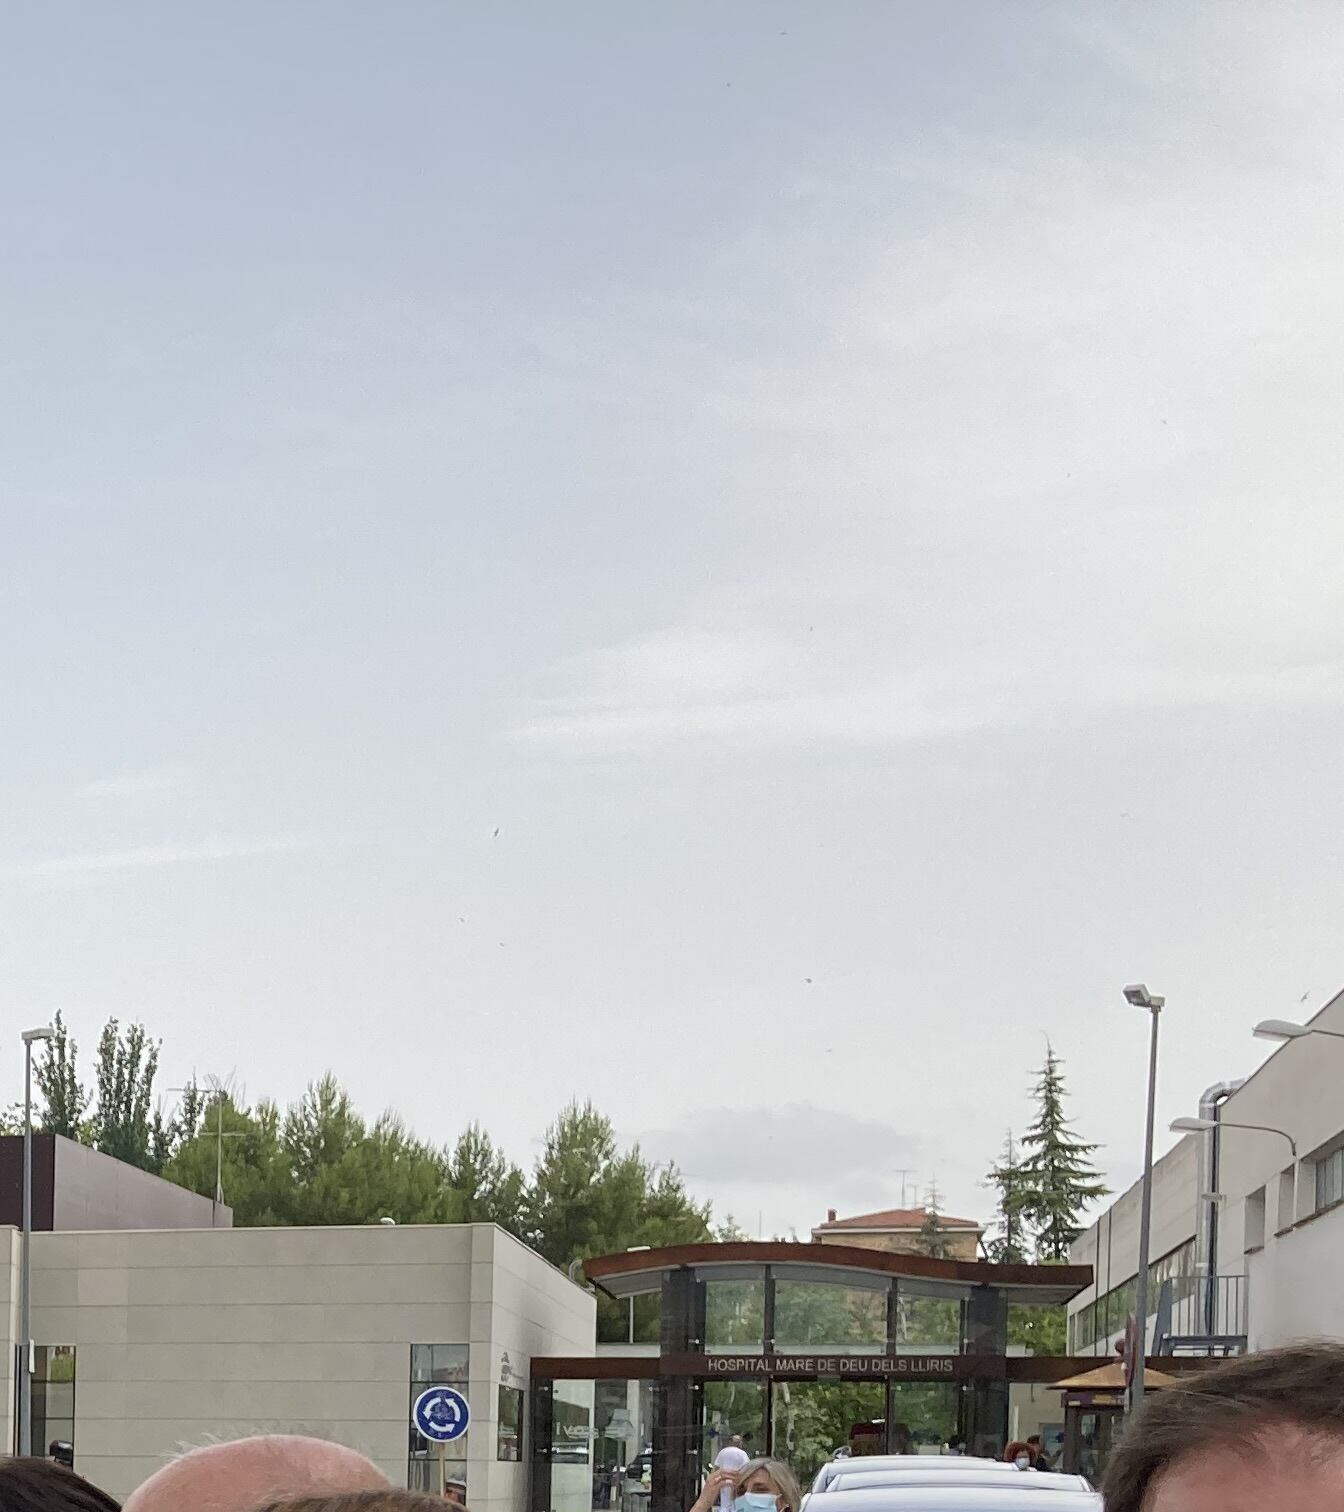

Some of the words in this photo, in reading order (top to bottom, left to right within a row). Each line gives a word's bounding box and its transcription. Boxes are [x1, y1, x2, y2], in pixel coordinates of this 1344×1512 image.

[708, 1358, 772, 1371] HOSPITAL
[776, 1358, 813, 1371] MARE
[817, 1358, 836, 1371] DE
[840, 1358, 868, 1371] DEU
[872, 1358, 907, 1371] DELS
[911, 1358, 953, 1371] LLIRIS
